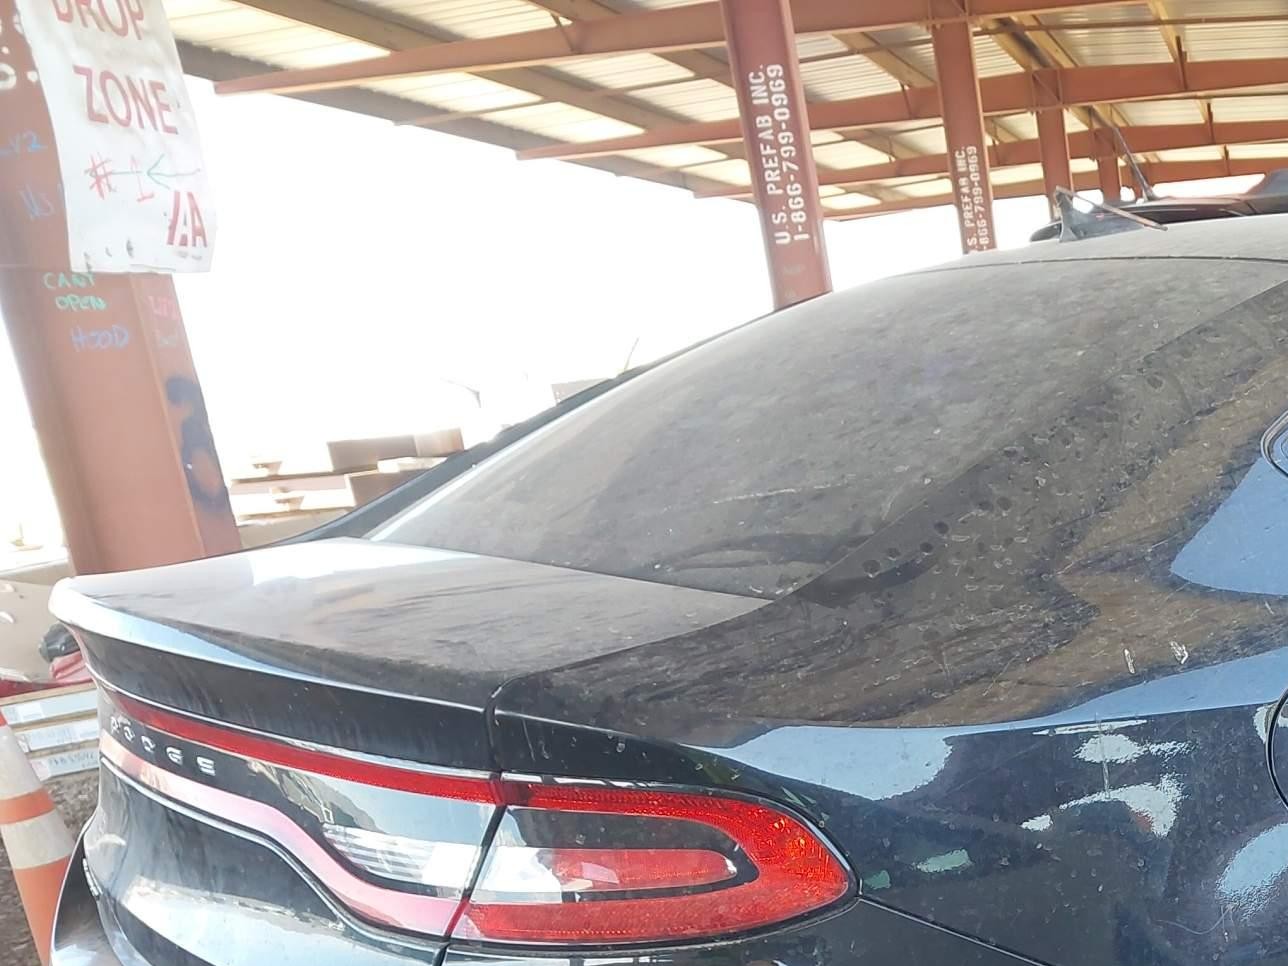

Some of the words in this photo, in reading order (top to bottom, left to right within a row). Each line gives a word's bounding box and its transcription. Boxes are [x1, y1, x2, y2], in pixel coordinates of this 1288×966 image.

[73, 64, 178, 135] ZONE
[749, 64, 770, 105] INC.
[756, 114, 783, 195] PREFAB
[766, 64, 810, 241] 1-866-799-0969
[772, 204, 791, 245] U.S.
[959, 176, 975, 228] PREFAB
[966, 146, 990, 250] -866-799-0969
